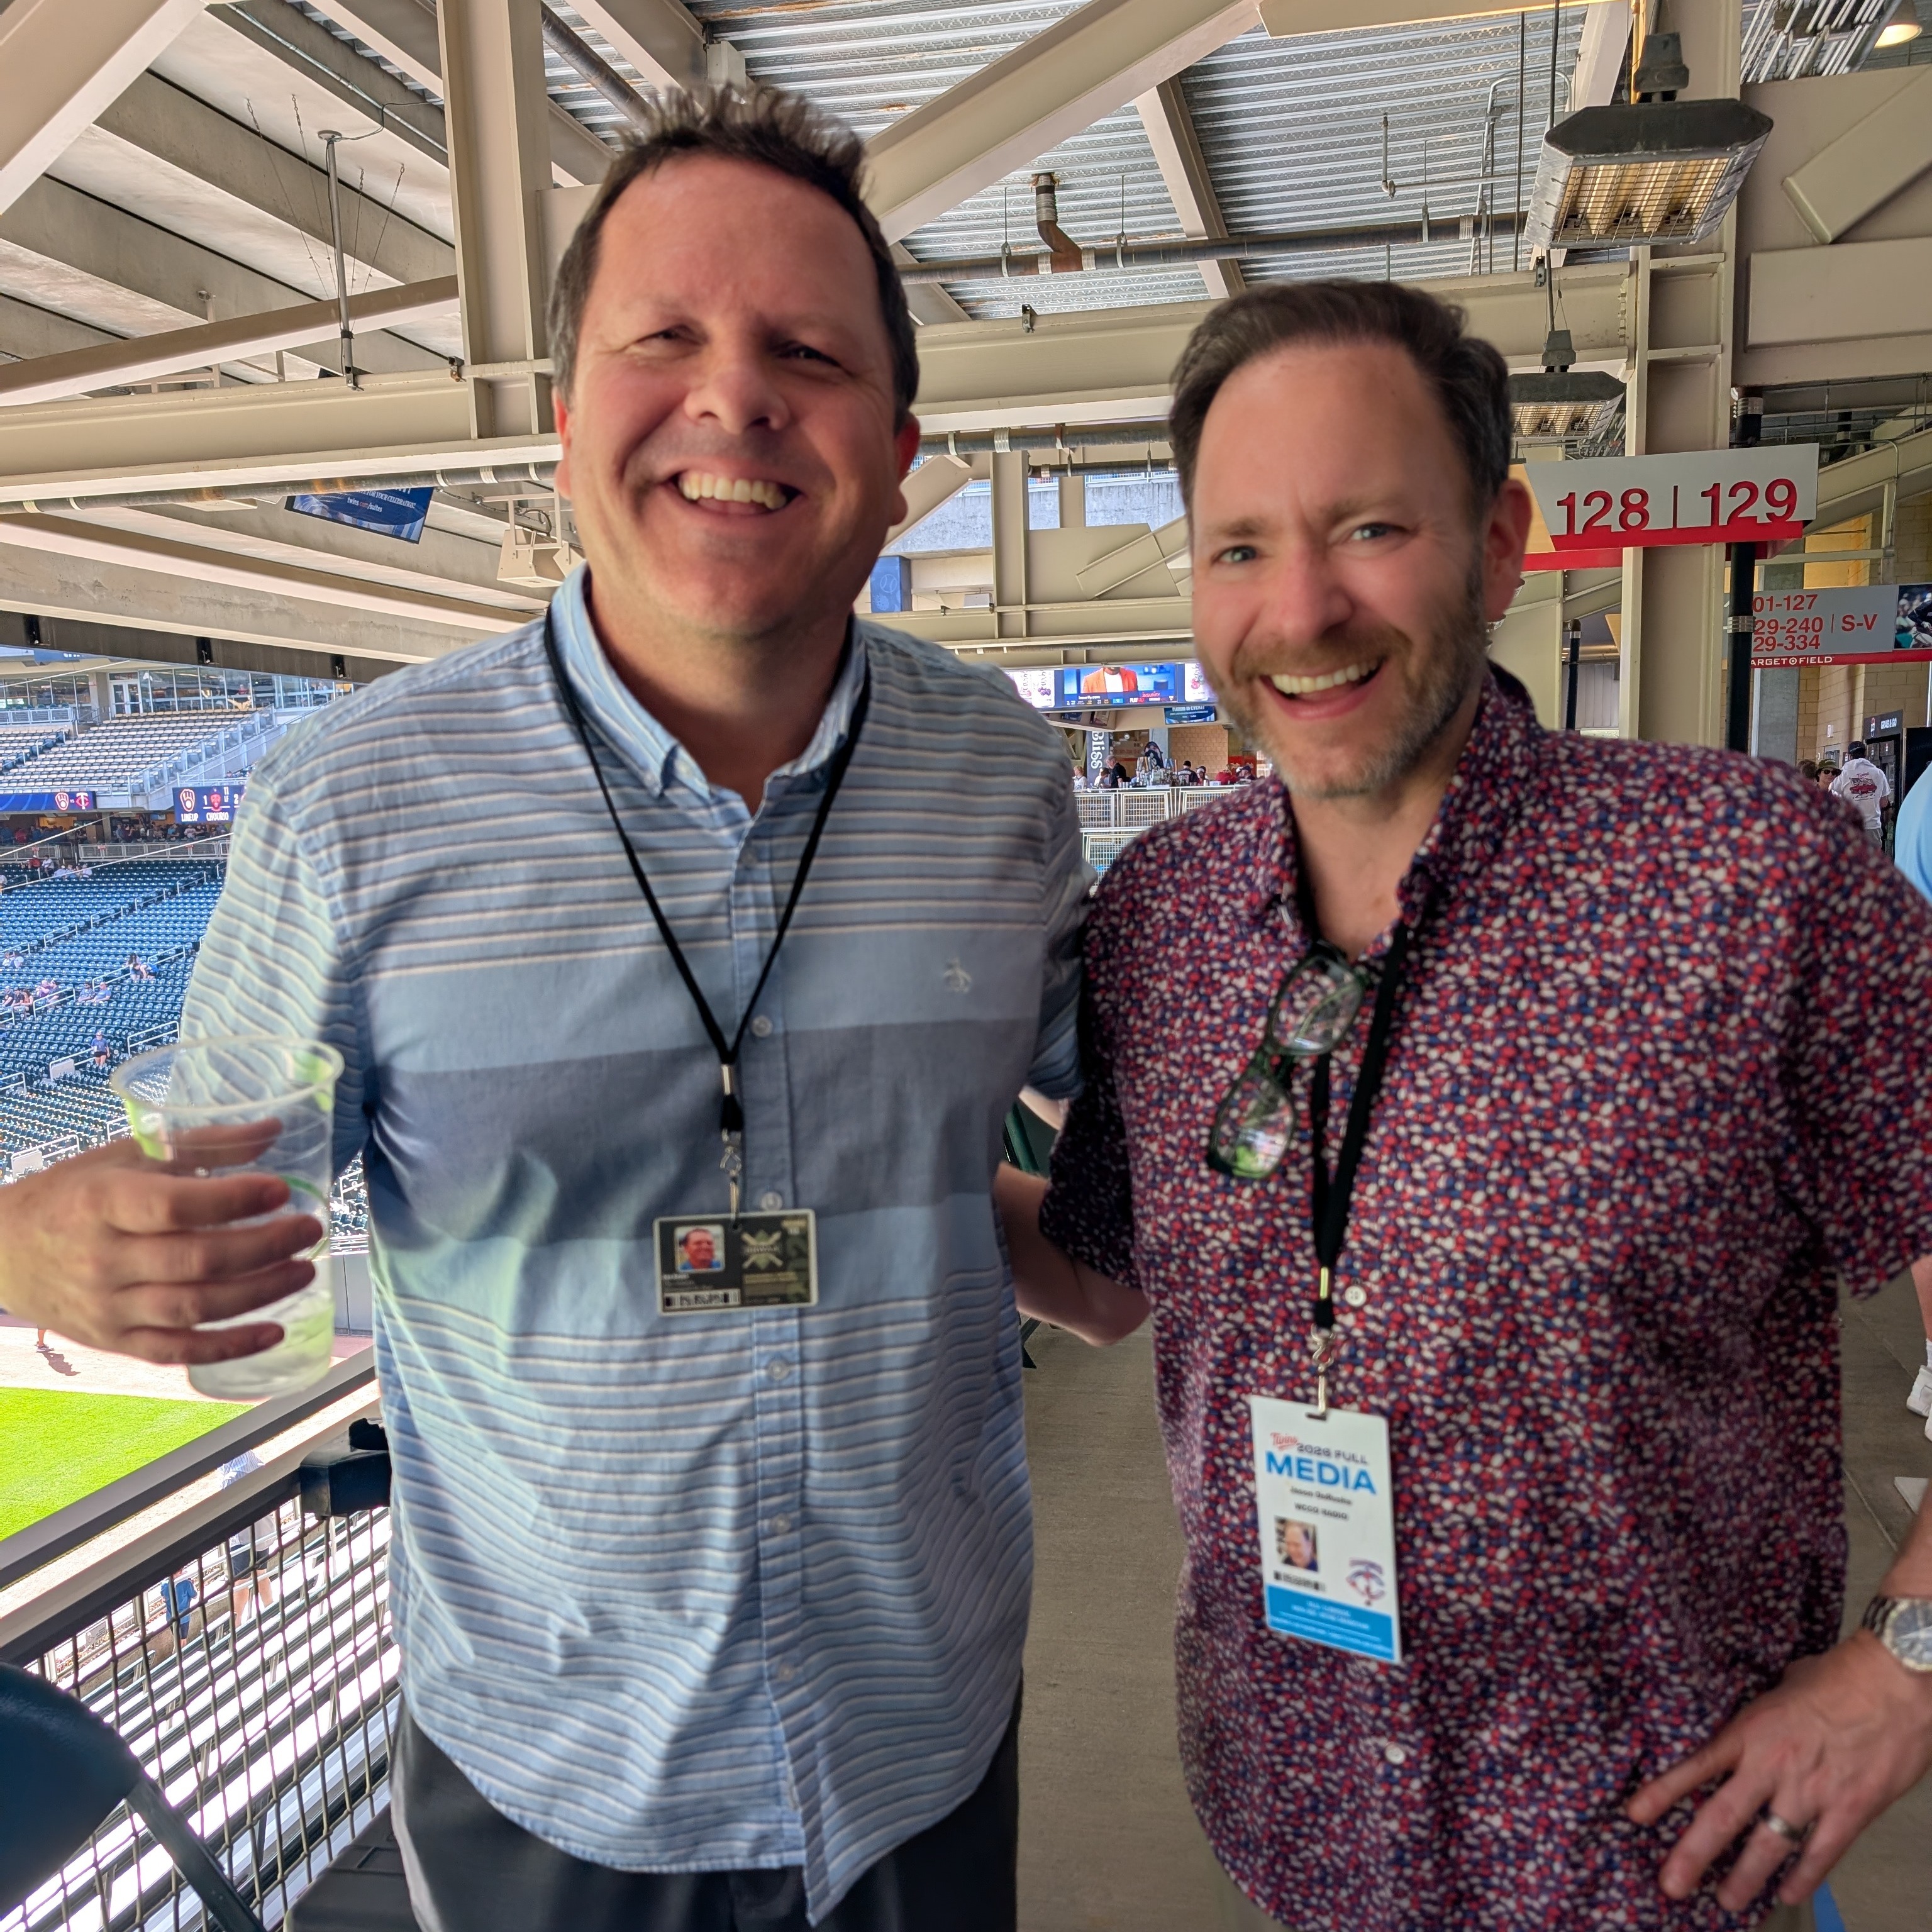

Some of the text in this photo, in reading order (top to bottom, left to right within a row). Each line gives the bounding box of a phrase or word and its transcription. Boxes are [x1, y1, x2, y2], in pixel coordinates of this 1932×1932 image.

[1557, 478, 1797, 535] 128 129
[1752, 594, 1818, 613] 01-127
[1753, 613, 1878, 635] 29-240 S-V
[1753, 634, 1821, 652] 29-334
[1751, 656, 1833, 667] ARGET FIELD
[180, 813, 199, 822] LINEUP
[1335, 1450, 1368, 1465] FULL
[1265, 1450, 1377, 1495] MEDIA
